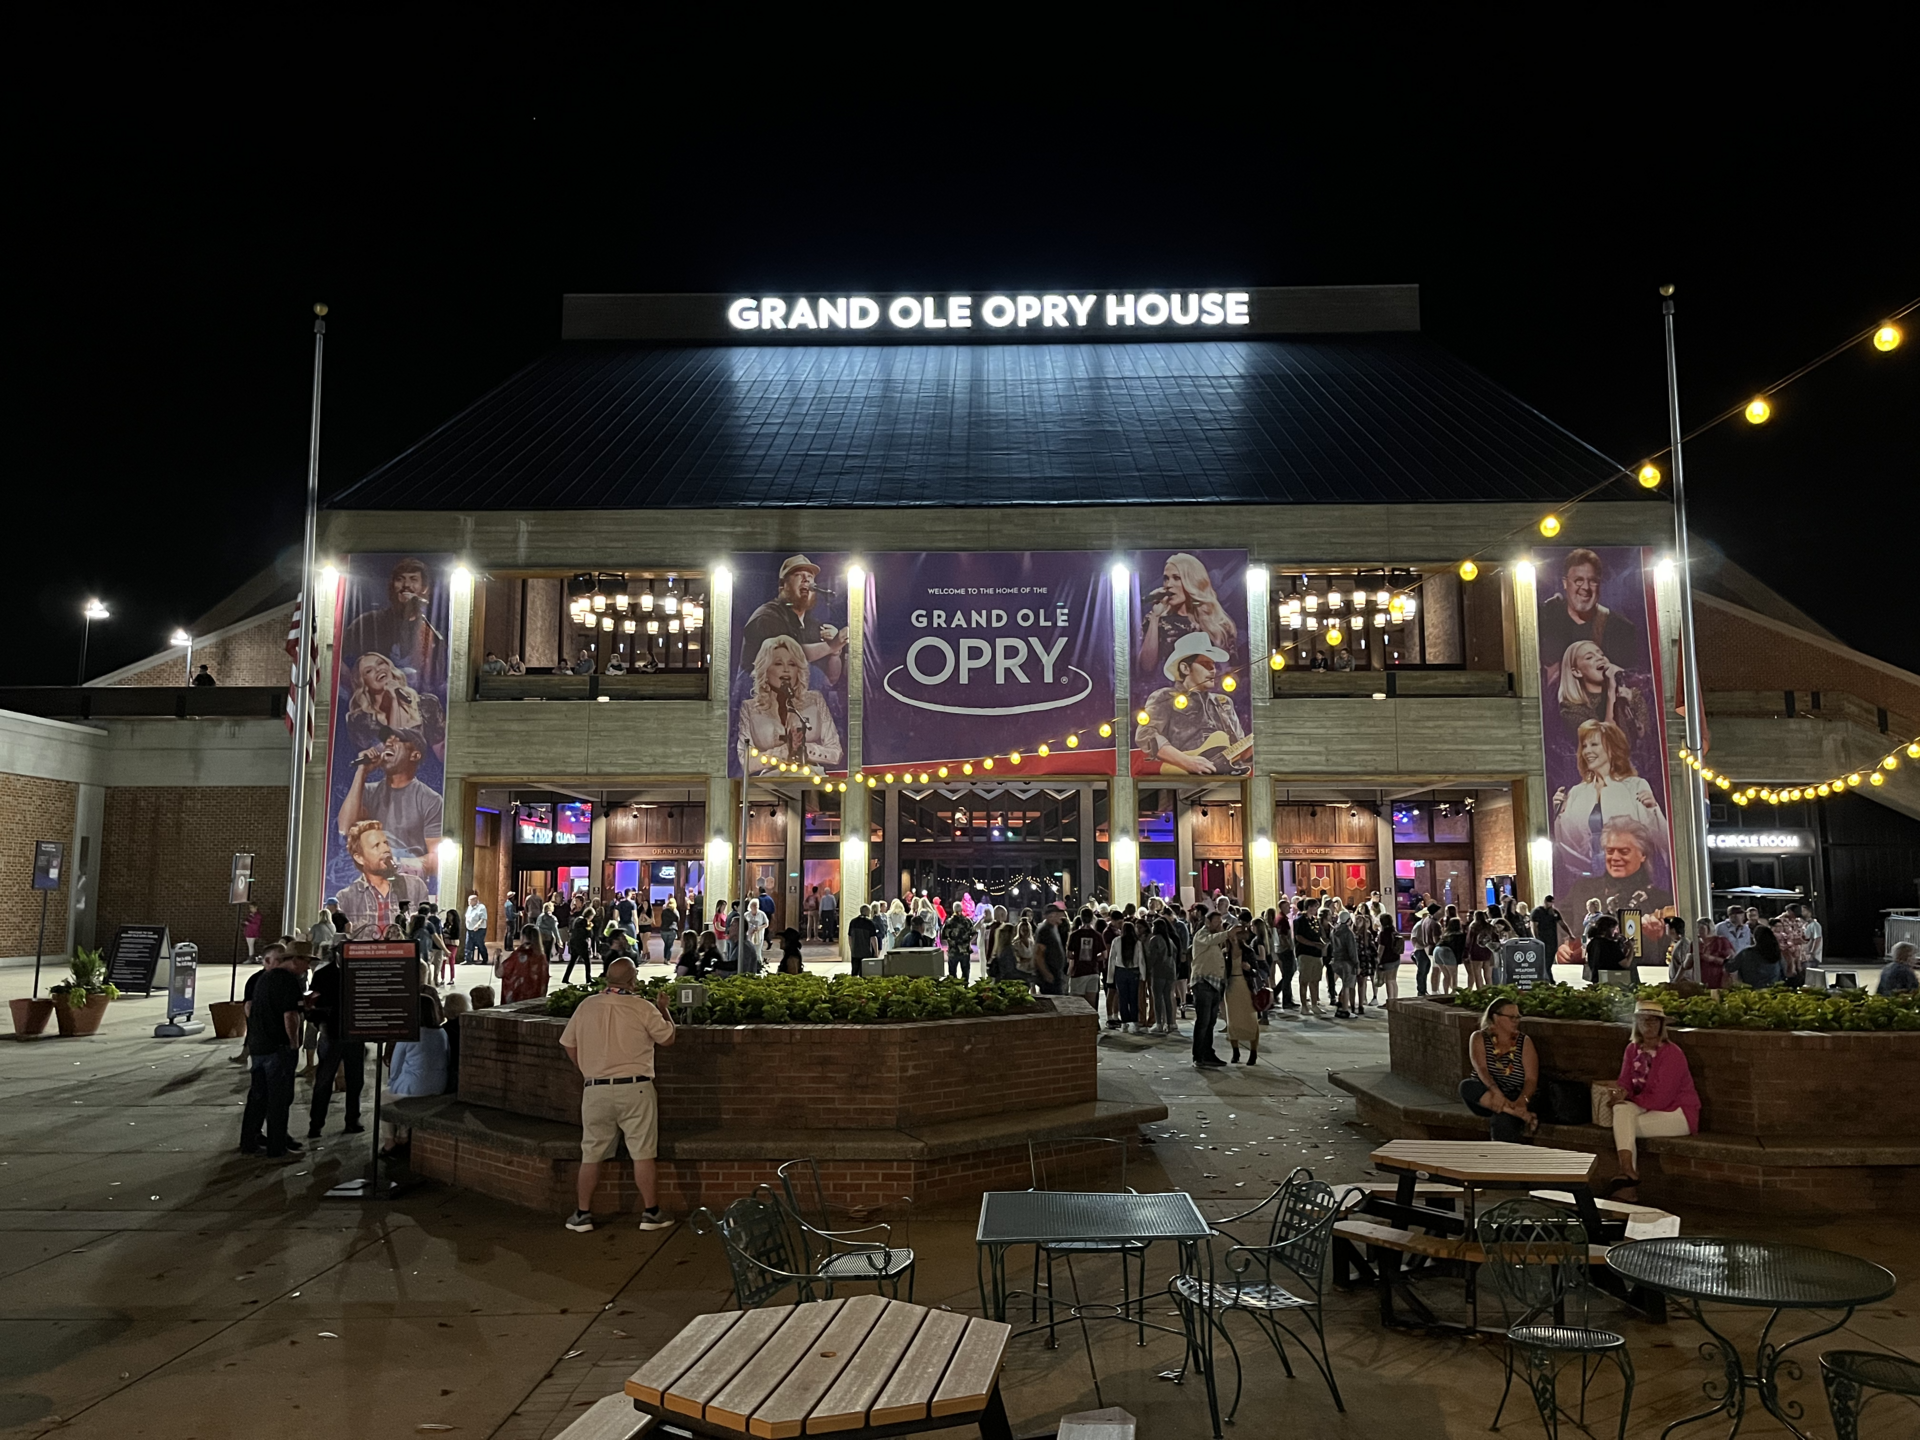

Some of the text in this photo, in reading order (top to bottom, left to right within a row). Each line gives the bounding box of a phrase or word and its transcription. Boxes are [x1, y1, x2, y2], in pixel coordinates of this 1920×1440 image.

[727, 292, 1250, 331] GRAND OLE OPRY HOUSE
[927, 587, 966, 595] WELCOME
[968, 587, 978, 595] TO
[911, 609, 1008, 628] GRAND
[906, 636, 1068, 685] OPRY
[1717, 834, 1760, 848] CIRCLE
[1760, 835, 1799, 847] ROOM
